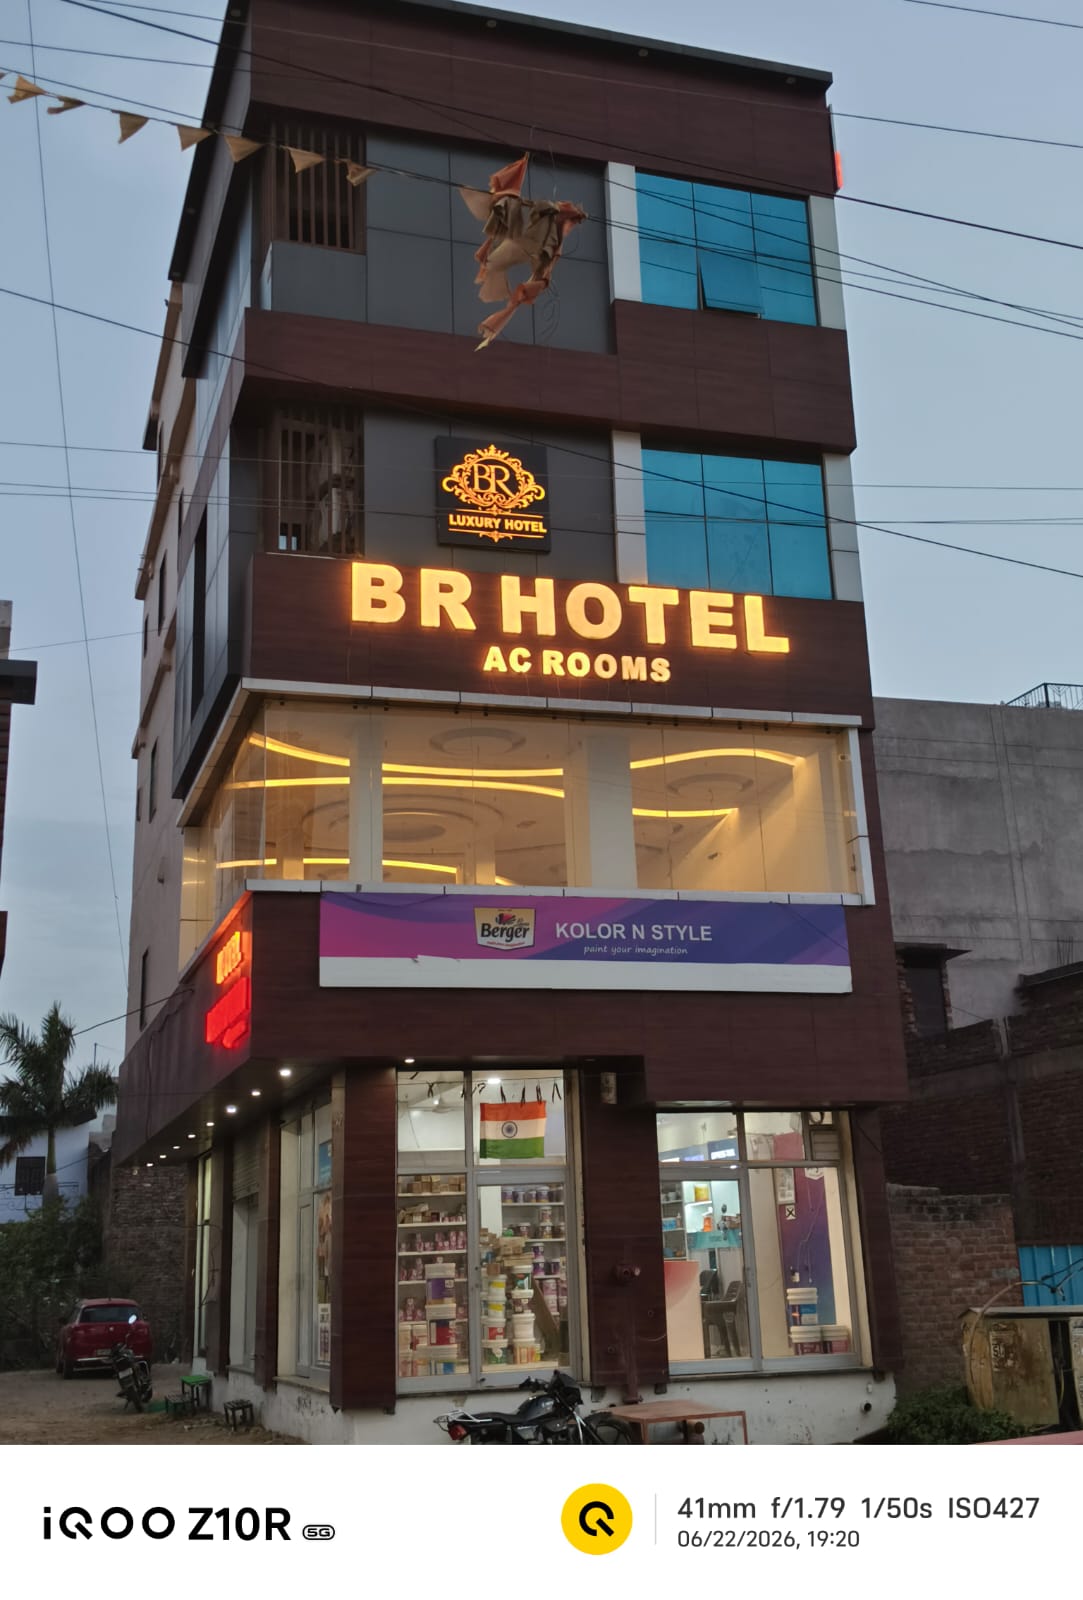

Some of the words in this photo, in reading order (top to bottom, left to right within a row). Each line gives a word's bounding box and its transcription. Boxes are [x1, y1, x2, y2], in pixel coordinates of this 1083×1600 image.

[472, 463, 516, 498] BR
[448, 514, 501, 529] LUXURY
[504, 519, 547, 533] HOTEL
[351, 562, 477, 631] BR
[500, 574, 790, 654] HOTEL
[483, 646, 532, 673] AC
[542, 650, 671, 682] ROOMS
[480, 922, 530, 943] Berger
[555, 922, 626, 940] KOLOR
[632, 924, 645, 940] N
[651, 925, 713, 942] STYLE
[583, 946, 608, 956] paint
[611, 946, 632, 956] your
[634, 946, 688, 957] imagination
